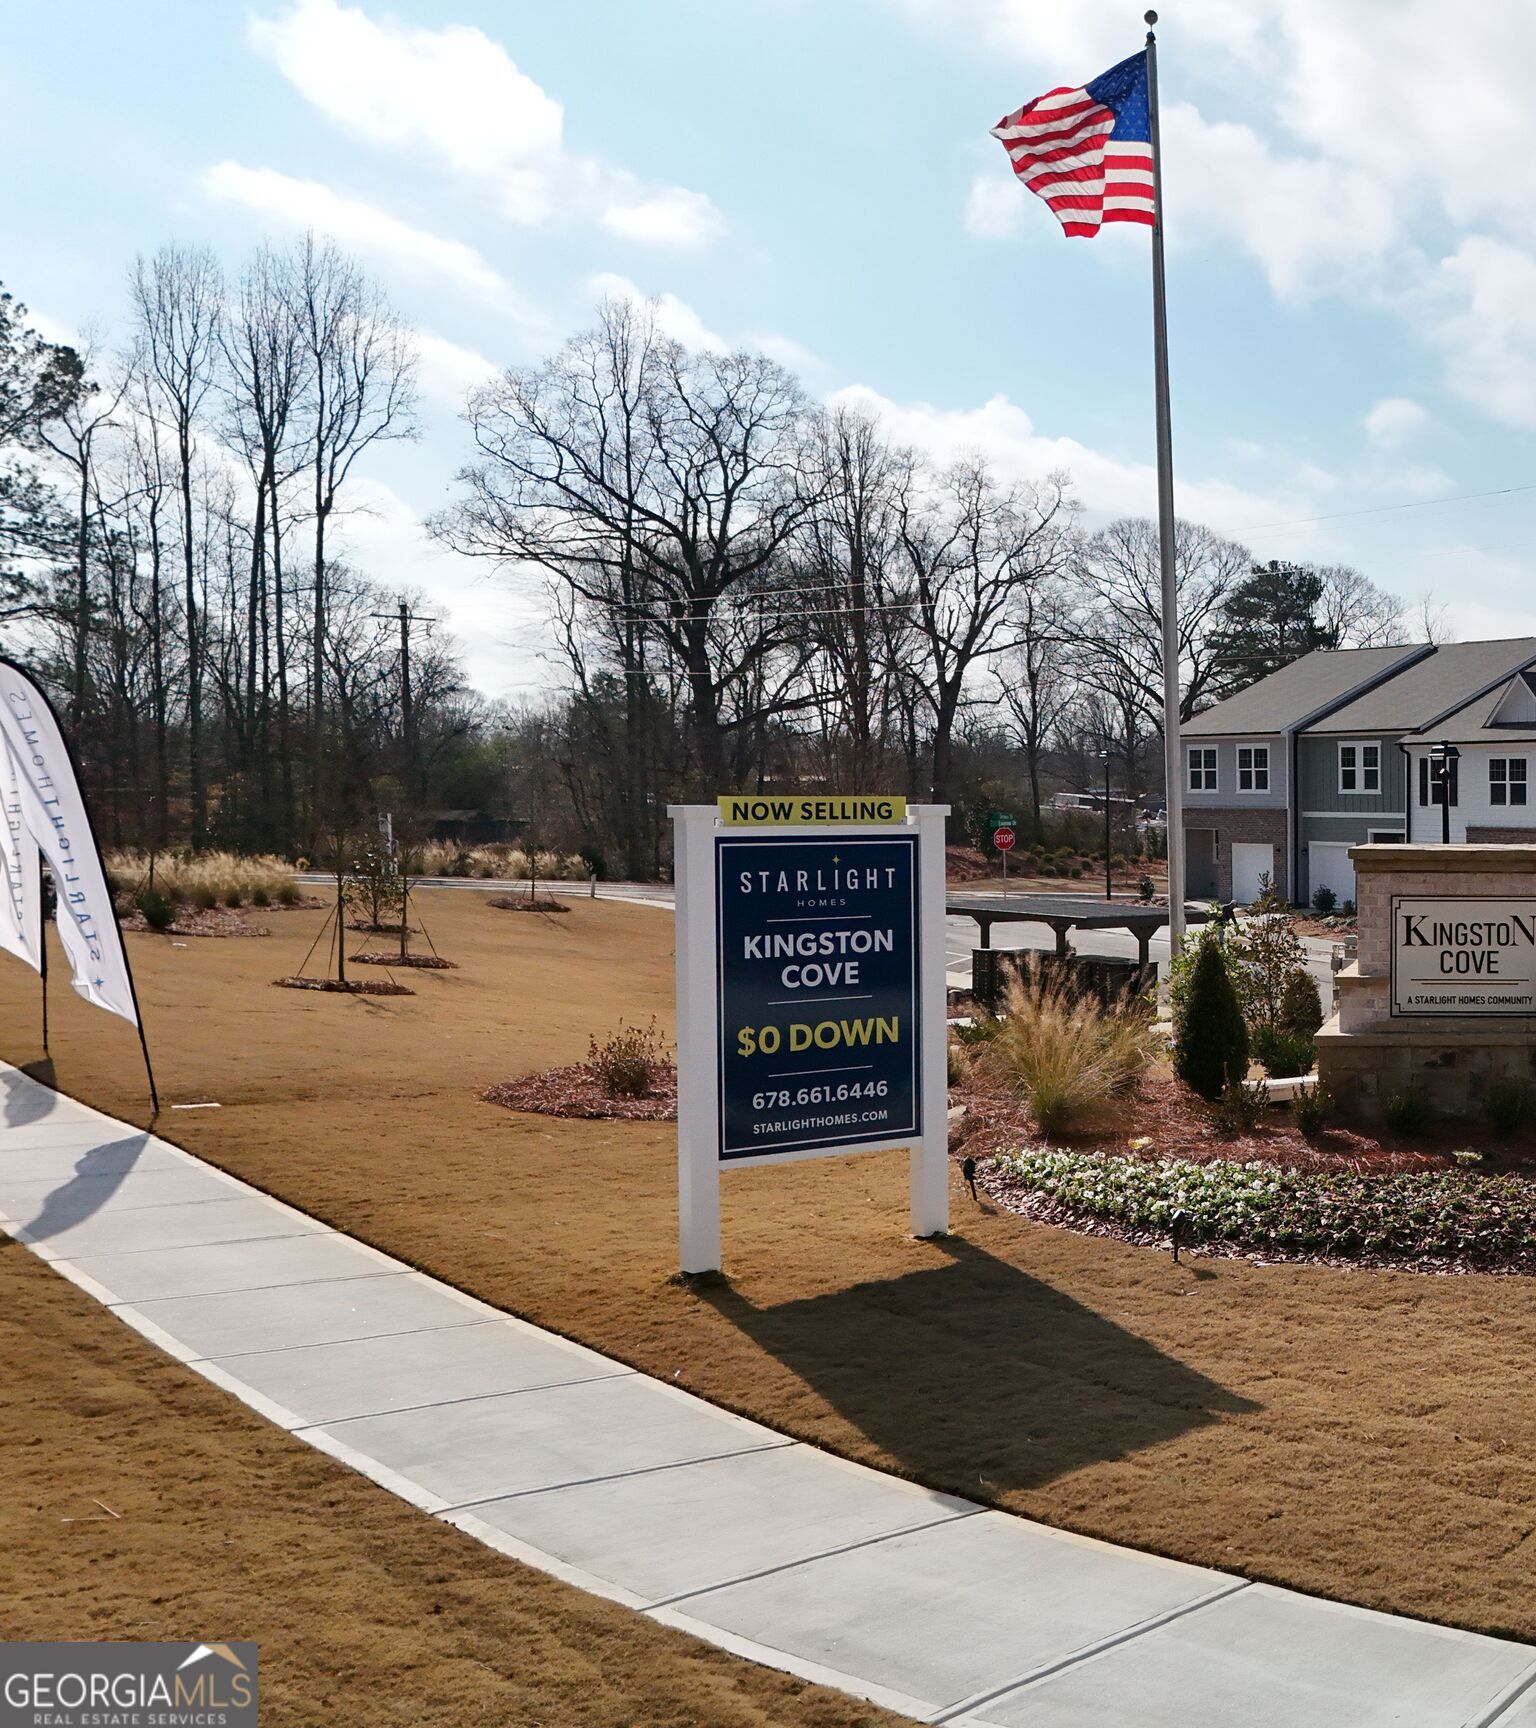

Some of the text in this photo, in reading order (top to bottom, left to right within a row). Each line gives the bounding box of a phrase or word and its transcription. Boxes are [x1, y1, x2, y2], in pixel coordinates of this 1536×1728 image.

[732, 802, 893, 820] NOW SELLING
[995, 834, 1014, 844] STOP
[740, 867, 896, 894] STARLIGHT
[797, 898, 846, 907] HOMES
[743, 928, 894, 960] KINGSTON
[781, 961, 860, 989] COVE
[1440, 950, 1500, 974] COVE
[1407, 995, 1533, 1005] A STARLIGHT HOMES COMMUNITY
[737, 1016, 899, 1058] $0 DOWN
[752, 1080, 888, 1110] 678.661.6446
[753, 1109, 888, 1135] STARLIGHTHOMES.COM
